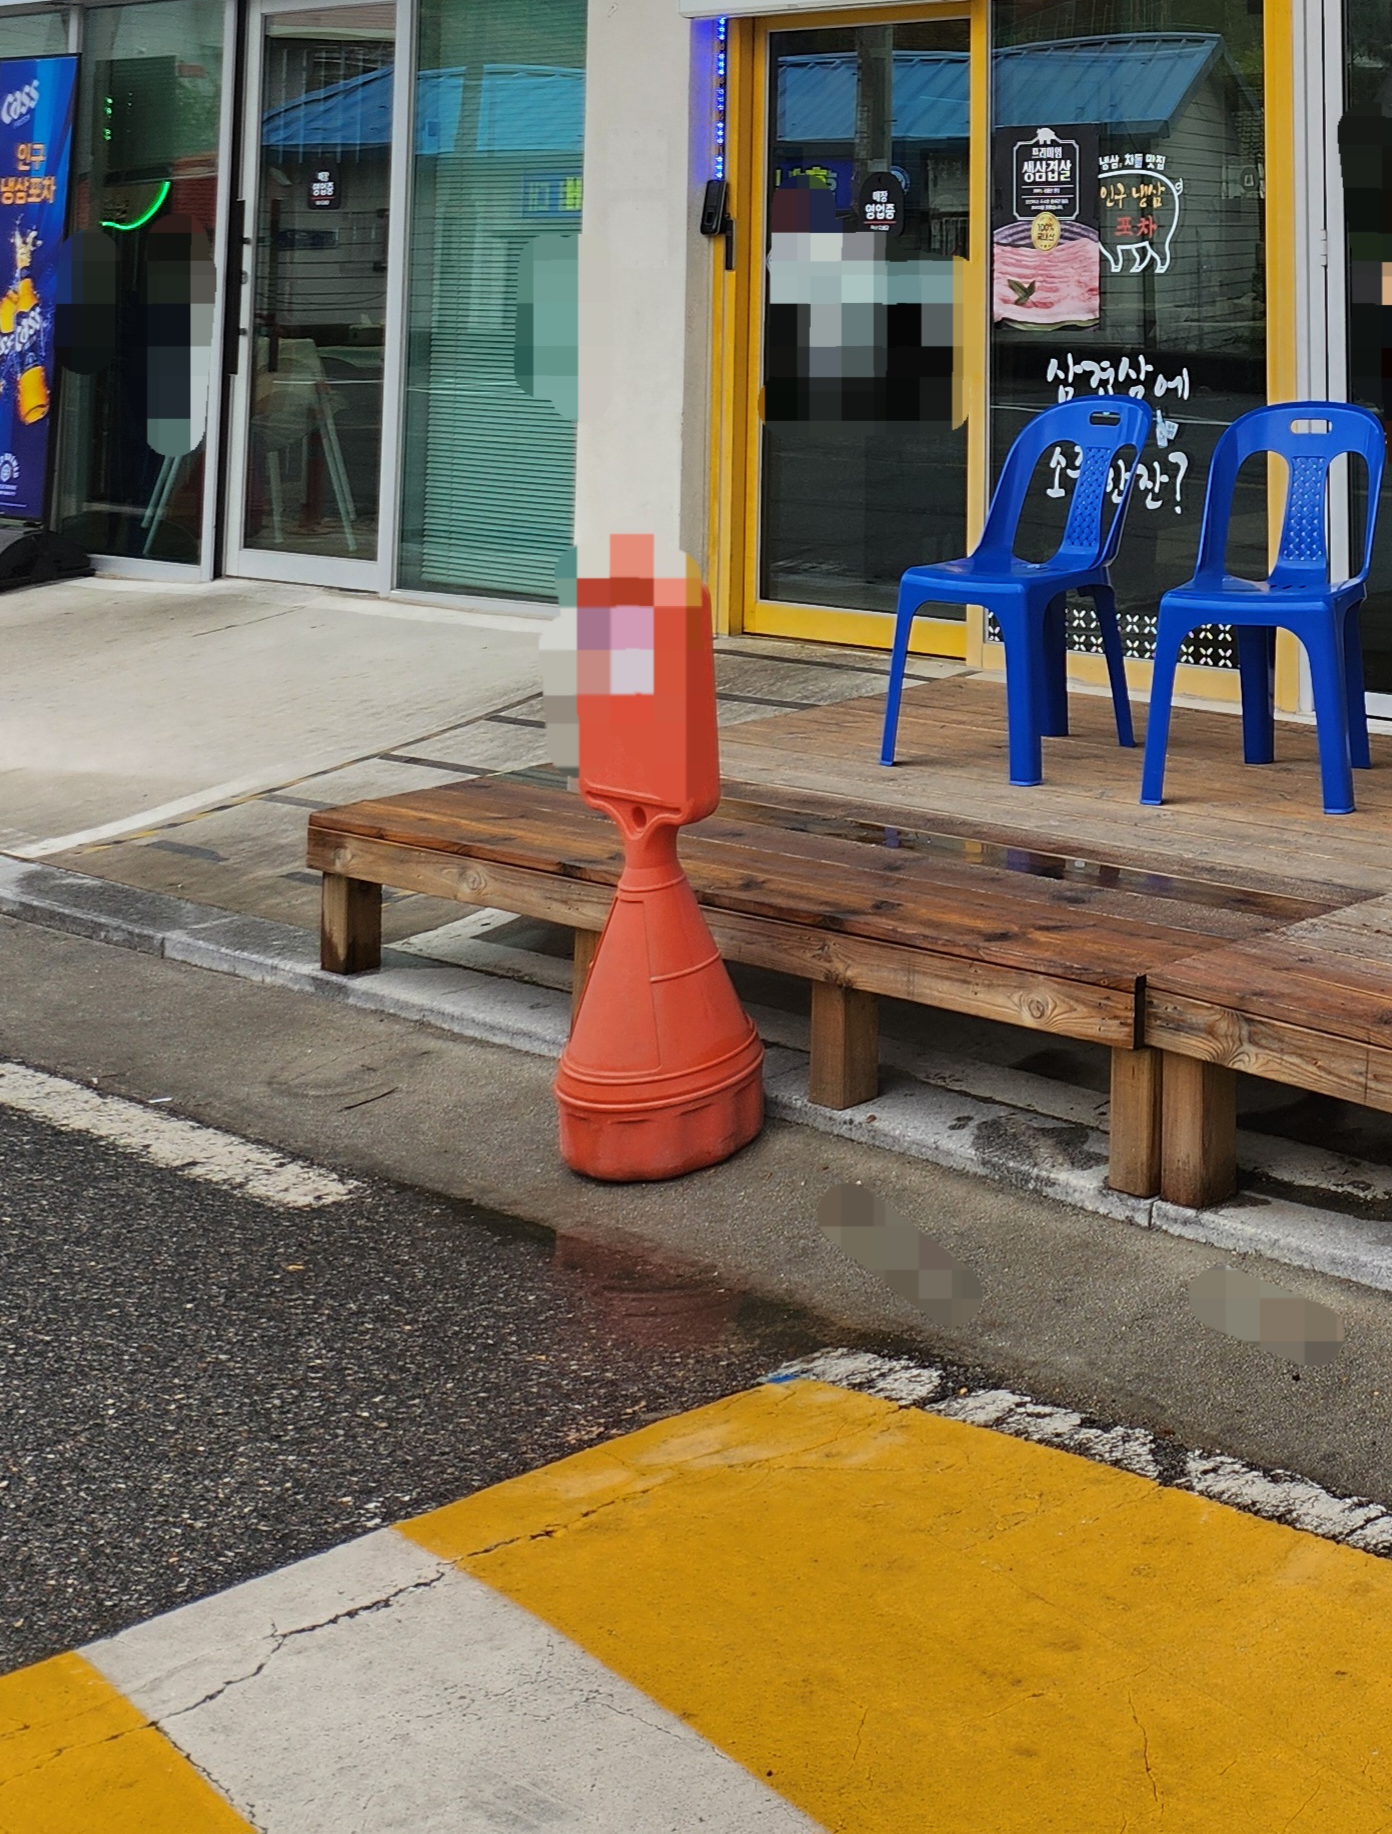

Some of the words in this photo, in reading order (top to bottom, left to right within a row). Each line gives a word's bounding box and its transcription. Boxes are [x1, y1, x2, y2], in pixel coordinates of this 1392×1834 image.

[17, 142, 47, 172] 인구
[1031, 146, 1063, 159] 프리미엄
[1124, 153, 1144, 169] 차돌
[1145, 153, 1167, 171] 맛집
[1021, 160, 1073, 183] 생삼겹살
[1100, 182, 1127, 209] 인구
[1131, 181, 1167, 209] 냉삼
[865, 203, 896, 220] 영업중
[1036, 222, 1055, 233] 100%
[1036, 232, 1055, 243] 국내산
